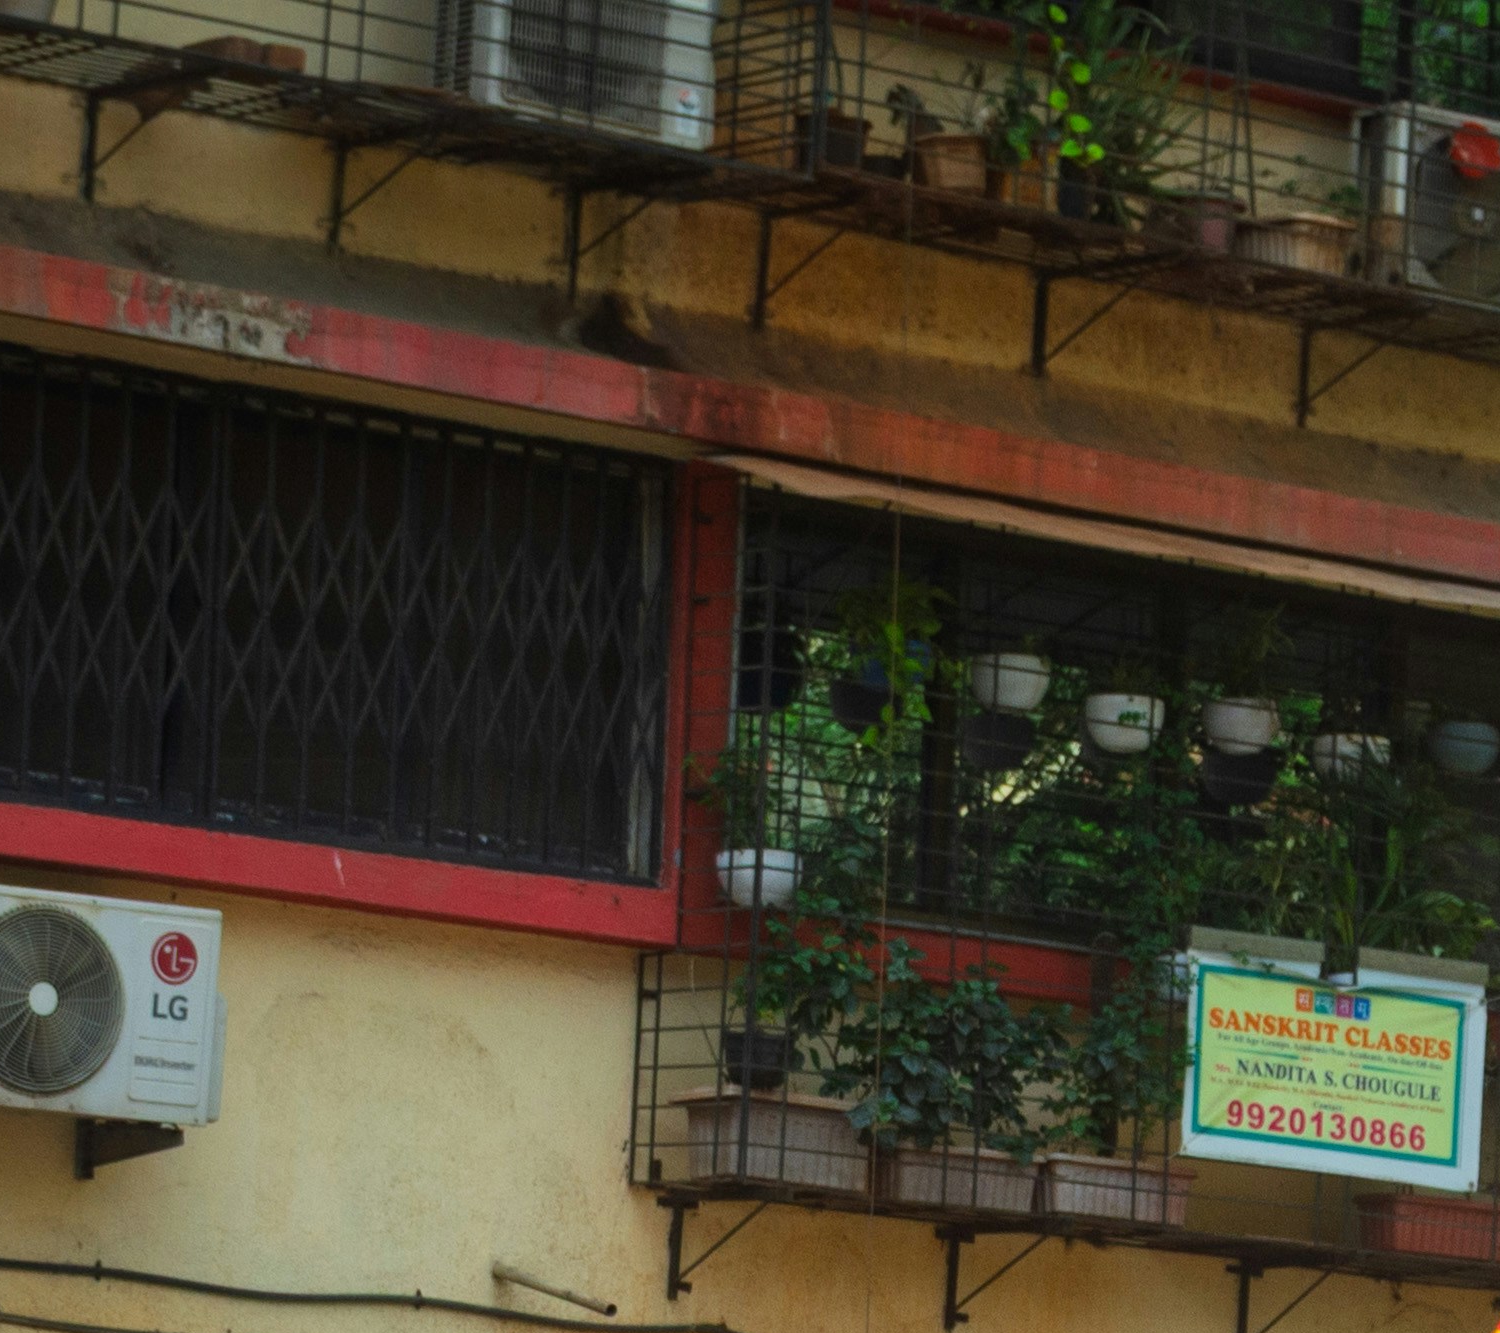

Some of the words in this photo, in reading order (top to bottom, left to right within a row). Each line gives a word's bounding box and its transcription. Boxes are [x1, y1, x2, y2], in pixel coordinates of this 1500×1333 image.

[152, 993, 189, 1022] LG
[1208, 1007, 1340, 1044] SANSKRIT
[1345, 1026, 1452, 1061] CLASSES
[1236, 1059, 1318, 1085] NANDITA
[1323, 1073, 1339, 1088] S.
[1342, 1073, 1441, 1102] CHOUGULE
[1227, 1099, 1426, 1152] 9920130866
